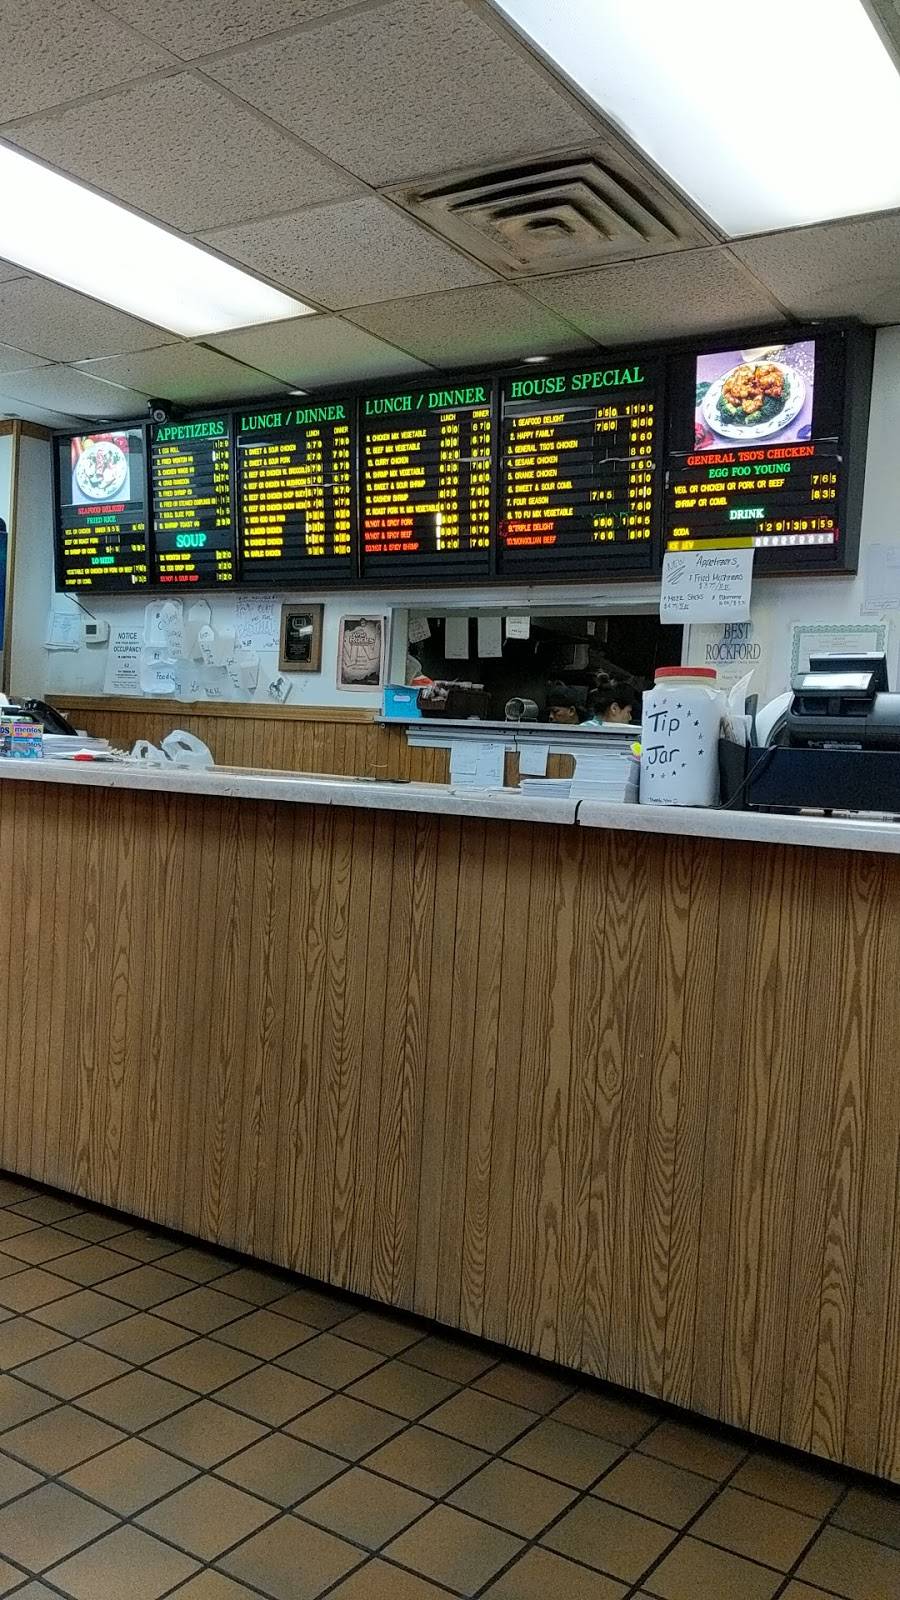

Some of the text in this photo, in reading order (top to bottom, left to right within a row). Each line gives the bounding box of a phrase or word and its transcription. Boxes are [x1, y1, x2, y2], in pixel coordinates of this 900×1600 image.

[511, 366, 645, 399] HOUSE SPECIAL
[365, 387, 487, 415] LUNCH / DINNER
[241, 405, 346, 430] LUNCH / DINNER
[440, 409, 490, 422] LUNCH DINNER
[518, 415, 542, 427] SEAFOOD
[543, 414, 565, 424] DELIGHT
[625, 404, 654, 415] 1199
[156, 421, 224, 441] APPETIZERS
[306, 426, 349, 438] LUNCH DINNER
[516, 430, 534, 440] HAPPY
[535, 427, 555, 438] FAMILY
[514, 444, 538, 453] GENERAL
[556, 439, 579, 449] CHICKEN
[537, 455, 559, 464] CHICKEN
[631, 446, 652, 456] 860
[686, 446, 815, 467] GENERAL TSO'S CHICKEN
[536, 467, 558, 477] CHICKEN
[708, 462, 791, 479] EGG FOO YOUNG
[514, 484, 533, 493] SWEET
[541, 481, 555, 490] SOUR
[689, 484, 699, 493] OR
[700, 482, 725, 493] CHICKEN
[727, 481, 737, 491] OR
[738, 480, 755, 490] PORK
[757, 480, 767, 488] OR
[769, 478, 785, 488] BEEF
[812, 474, 838, 485] 765
[513, 497, 527, 506] FOUR
[528, 496, 549, 505] SEASON
[674, 498, 697, 509] SHRIMP
[698, 497, 708, 507] OR
[812, 488, 837, 501] 835
[514, 510, 522, 519] TO
[523, 509, 531, 518] FU
[532, 509, 542, 518] MIX
[543, 507, 574, 517] VEGETABLE
[730, 508, 765, 522] DRINK
[532, 521, 555, 531] DELIGHT
[673, 527, 690, 537] SODA
[175, 533, 207, 547] SOUP
[594, 530, 613, 541] 760
[117, 631, 138, 641] NOTICE
[723, 622, 752, 640] BEST
[705, 643, 761, 661] ROCKFORD
[15, 726, 42, 734] mentos
[647, 710, 681, 737] Tip
[646, 745, 680, 765] Jar
